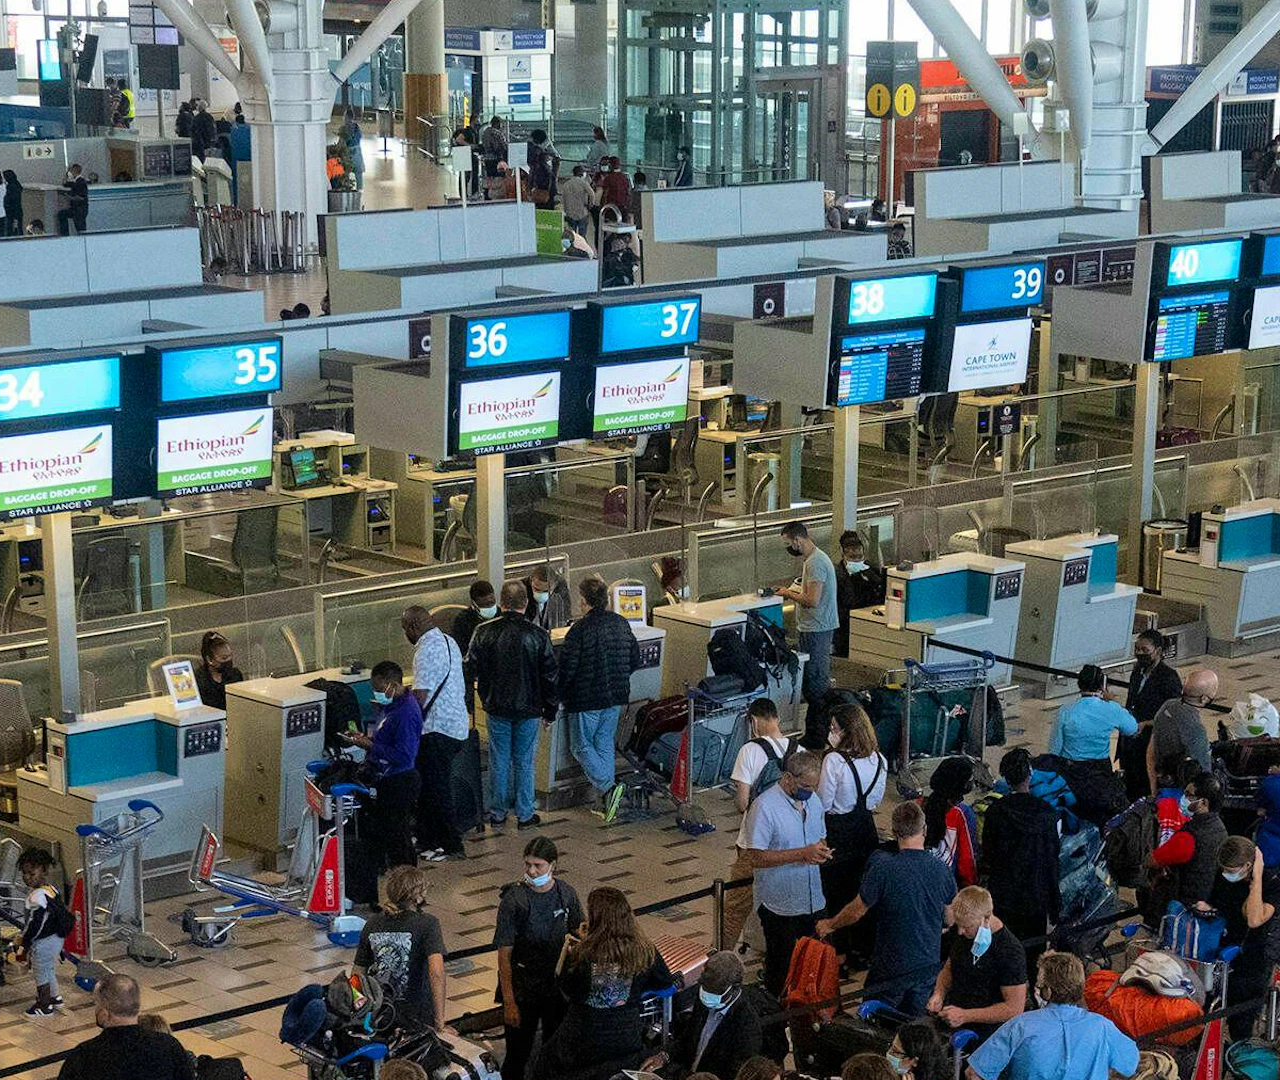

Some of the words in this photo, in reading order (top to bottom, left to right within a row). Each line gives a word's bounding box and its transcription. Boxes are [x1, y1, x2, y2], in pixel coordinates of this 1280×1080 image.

[1160, 73, 1183, 81] PROTECT
[1170, 249, 1198, 278] 40
[1011, 267, 1041, 299] 39
[851, 284, 885, 316] 38
[660, 302, 698, 338] 37
[469, 322, 507, 359] 36
[235, 346, 278, 385] 35
[965, 355, 987, 365] CAPE
[990, 352, 1016, 362] TOWN
[603, 381, 666, 397] Ethiopian
[468, 398, 536, 415] Ethiopian
[605, 416, 637, 425] BAGGAGE
[639, 411, 675, 421] DROP-OFF
[472, 433, 507, 442] BAGGAGE
[508, 427, 546, 437] DROP-OFF
[628, 424, 662, 434] ALLIANCE
[168, 435, 244, 452] Ethiopian
[496, 441, 532, 451] ALLIANCE
[0, 454, 82, 473] Ethiopian
[172, 472, 212, 483] BAGGAGE
[214, 466, 257, 478] DROP-OFF
[5, 492, 47, 504] BAGGAGE
[50, 486, 96, 497] DROP-OFF
[200, 481, 242, 492] ALLIANCE
[9, 509, 34, 517] STAR
[36, 502, 81, 514] ALLIANCE
